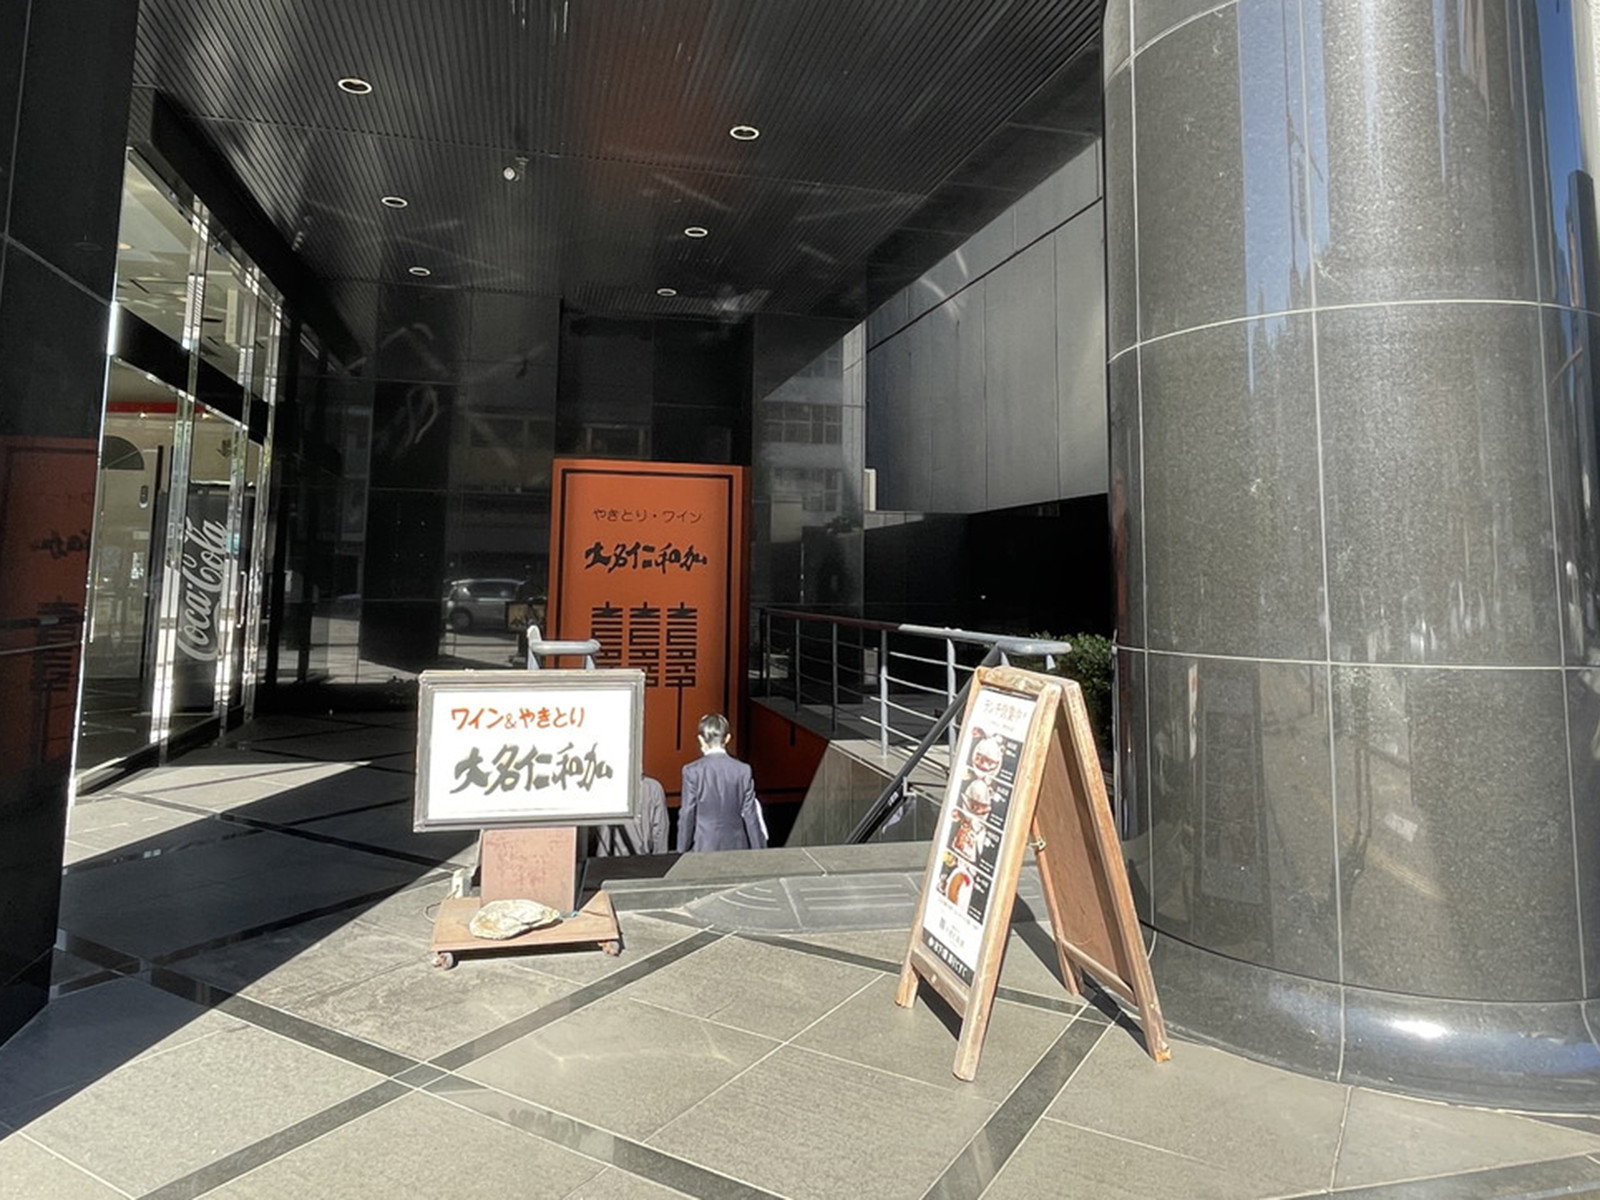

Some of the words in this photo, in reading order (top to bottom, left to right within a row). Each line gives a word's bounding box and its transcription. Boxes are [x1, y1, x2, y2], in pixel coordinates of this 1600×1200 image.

[594, 509, 702, 524] やきとり・ワイン
[585, 542, 708, 574] 大名仁和加
[451, 707, 585, 730] ワイン&やきとり
[450, 742, 613, 795] 大名仁和加
